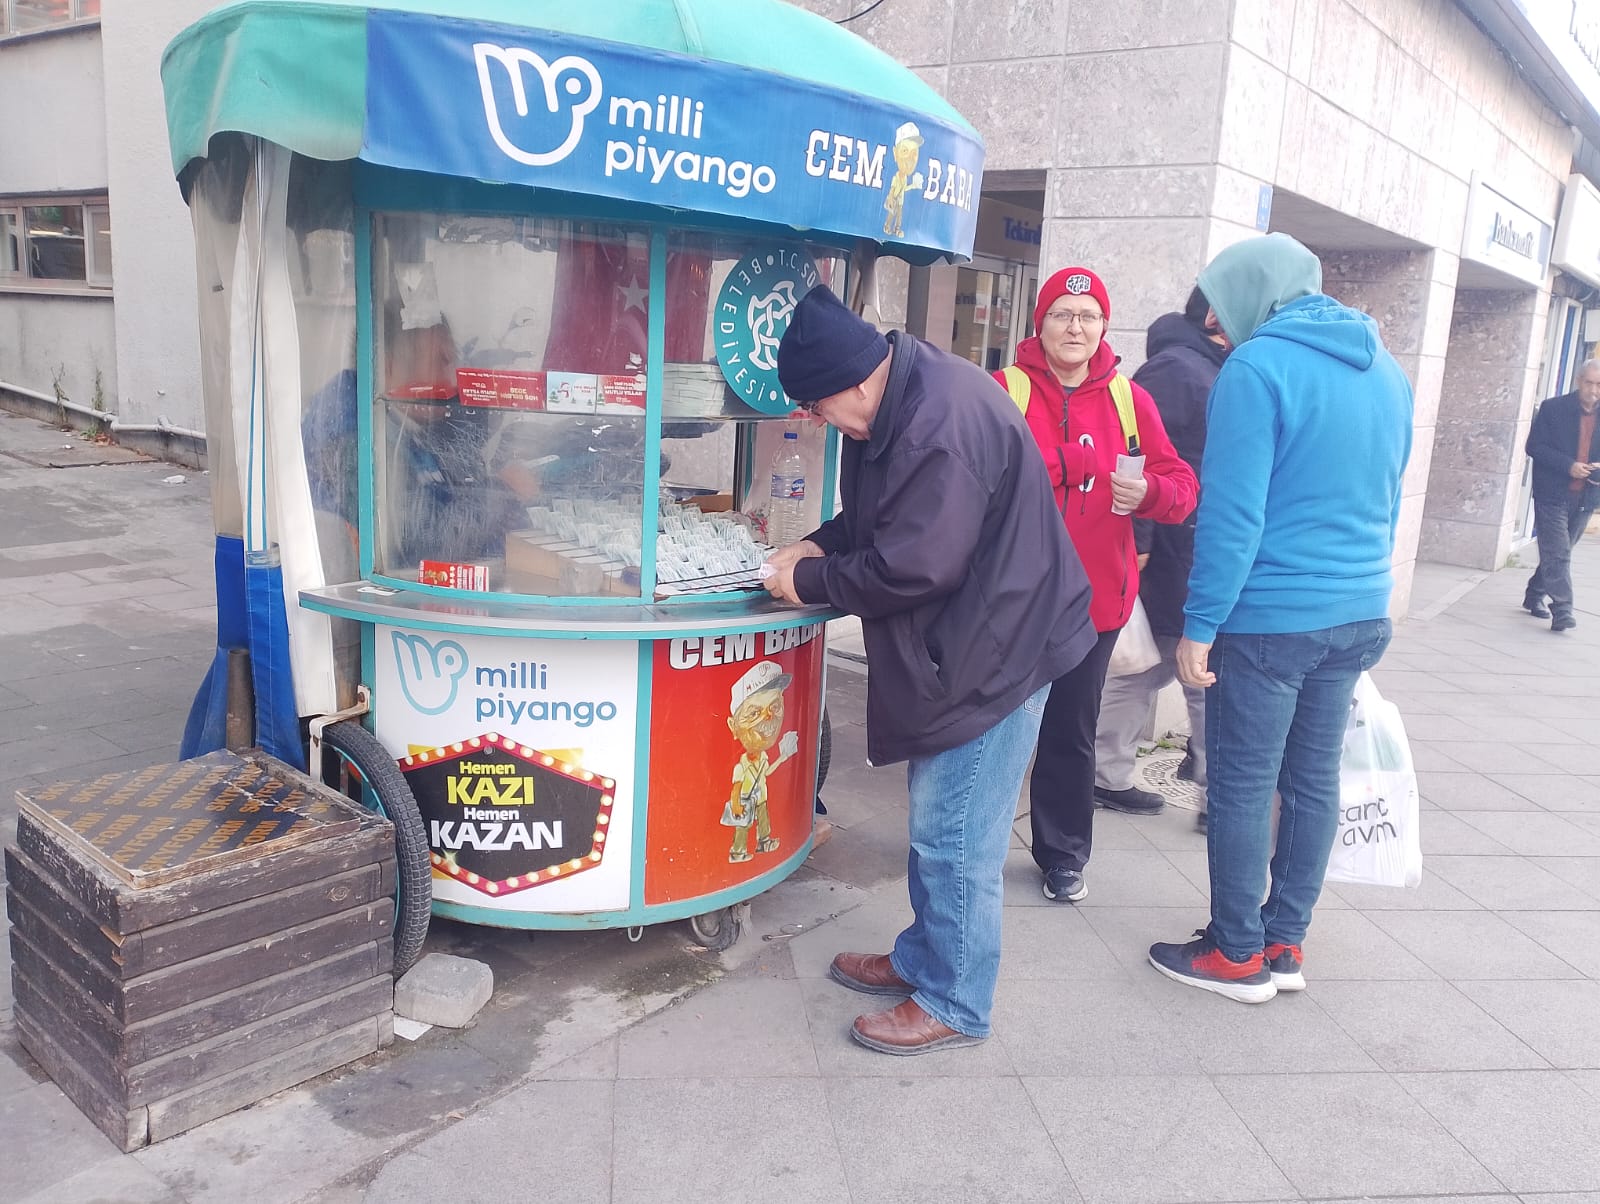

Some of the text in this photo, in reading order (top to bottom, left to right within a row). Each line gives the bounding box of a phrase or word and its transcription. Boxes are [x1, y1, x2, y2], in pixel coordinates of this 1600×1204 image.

[608, 94, 704, 139] milli
[605, 135, 777, 199] piyango
[805, 128, 974, 213] CEM BABA
[669, 632, 756, 670] CEM
[476, 661, 547, 690] milli
[476, 692, 617, 728] piyango
[459, 760, 516, 775] Hemen
[447, 776, 534, 806] KAZI
[463, 806, 519, 821] Hemen
[430, 820, 563, 851] KAZAN
[1342, 821, 1397, 847] avm
